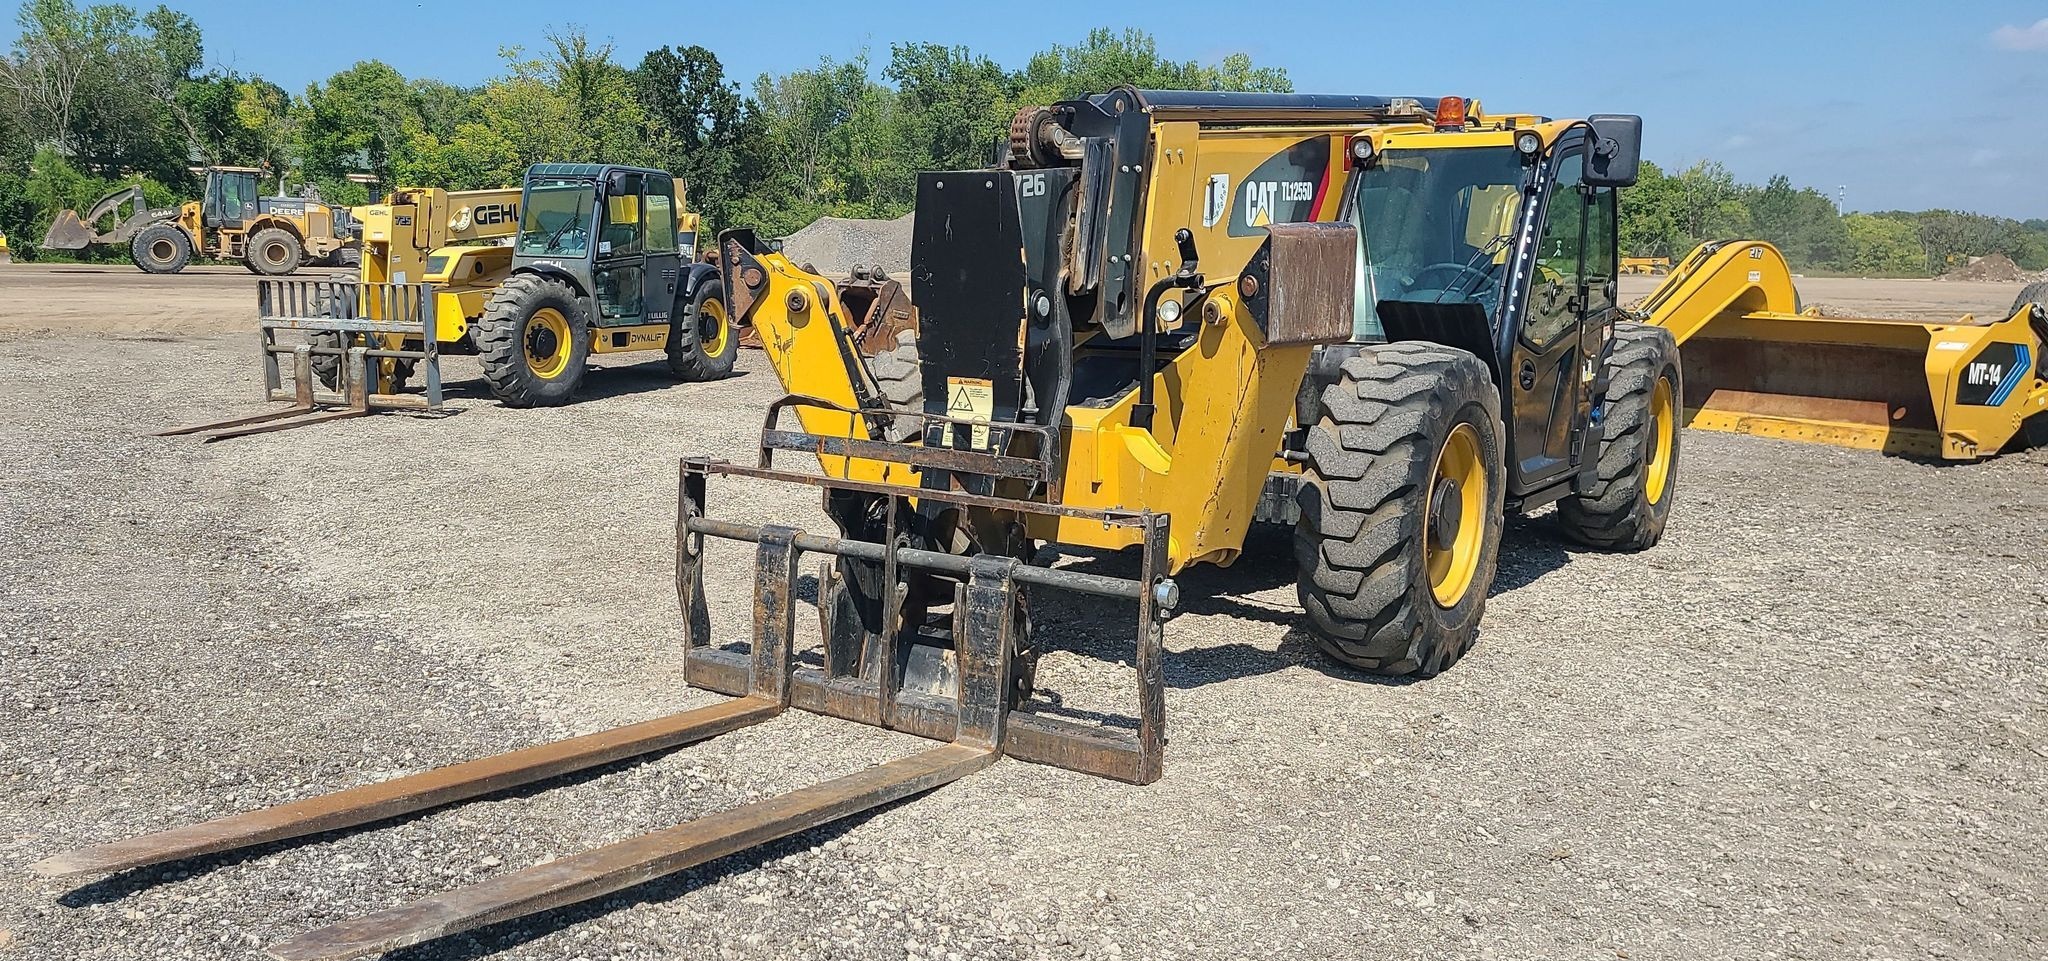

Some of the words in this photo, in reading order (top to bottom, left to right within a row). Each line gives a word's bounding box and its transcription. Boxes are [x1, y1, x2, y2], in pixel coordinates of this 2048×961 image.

[1015, 173, 1046, 197] 726
[269, 206, 304, 216] DEERE
[1245, 180, 1278, 228] CAT
[1281, 181, 1313, 201] TL1255D
[394, 215, 412, 226] 725
[473, 203, 520, 226] GEHL
[1749, 247, 1763, 259] 217
[631, 332, 666, 343] DYNALIFT
[1967, 362, 2002, 386] MT-14
